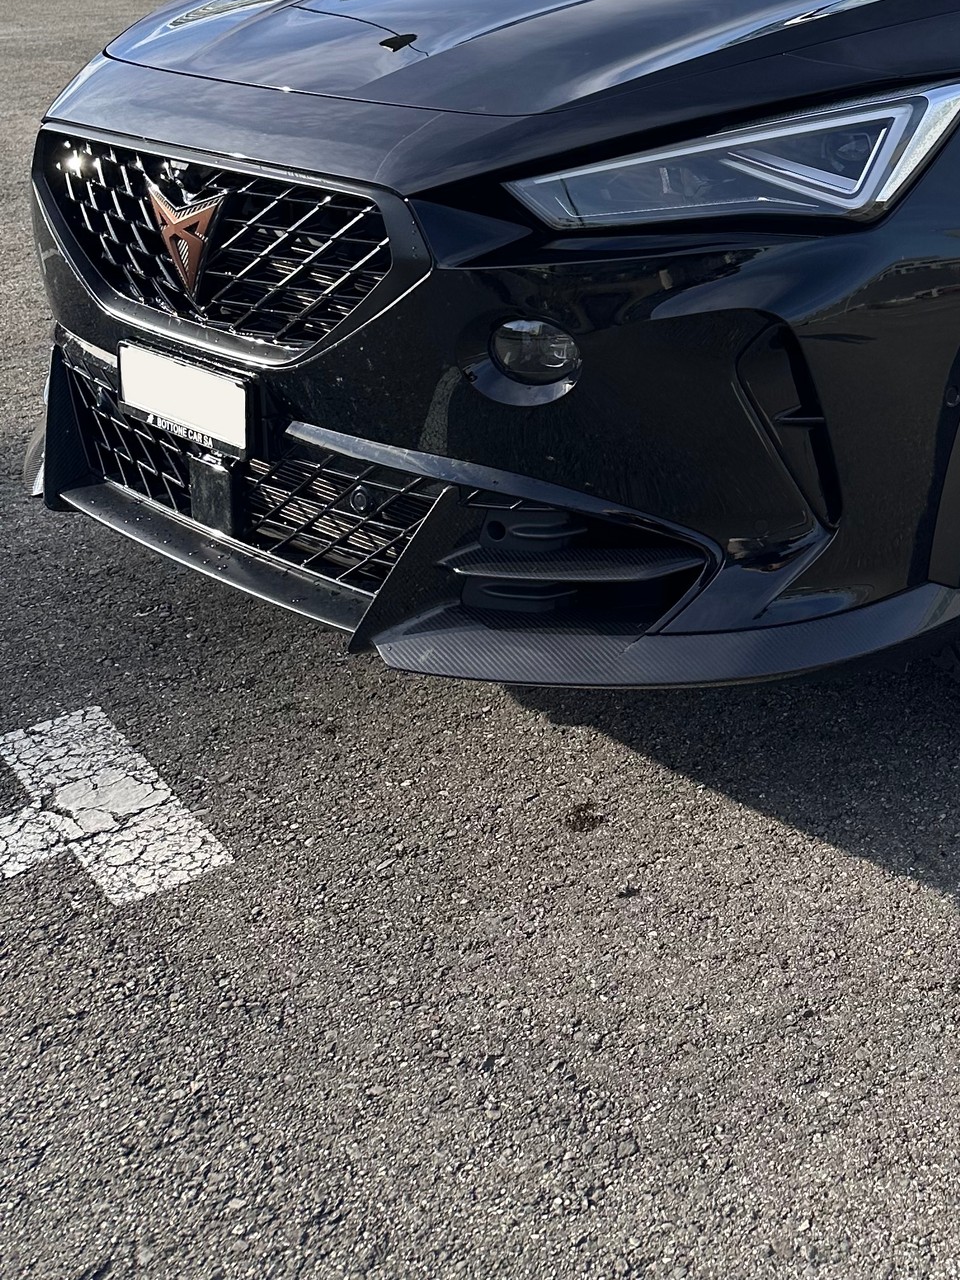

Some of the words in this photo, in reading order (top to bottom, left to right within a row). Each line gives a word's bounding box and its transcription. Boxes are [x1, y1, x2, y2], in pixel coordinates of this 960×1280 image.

[157, 417, 187, 438] BOTTONE
[188, 429, 203, 444] CAR
[203, 435, 214, 449] SA
